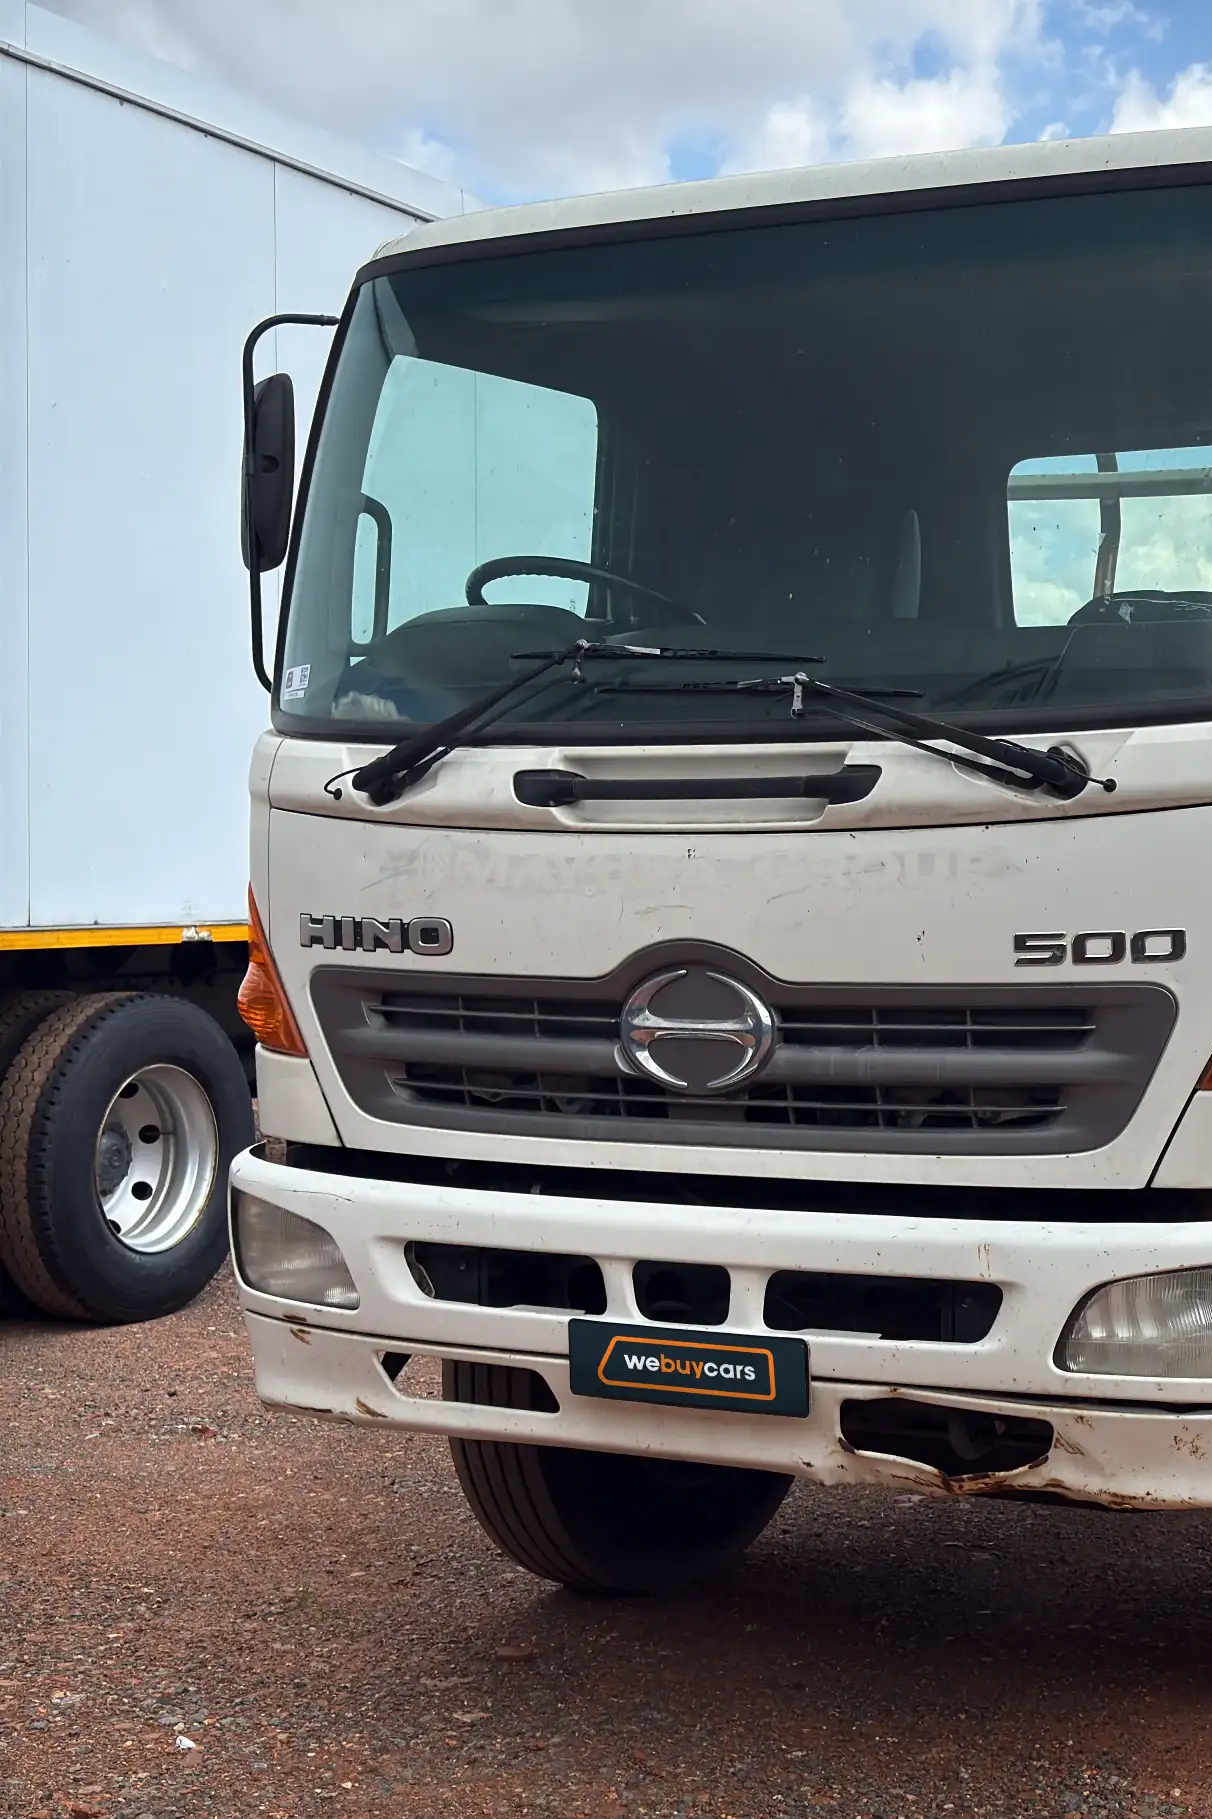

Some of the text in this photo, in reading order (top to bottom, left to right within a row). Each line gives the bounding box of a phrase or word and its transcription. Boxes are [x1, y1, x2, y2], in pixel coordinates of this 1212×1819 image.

[300, 913, 454, 956] HINO
[1013, 928, 1187, 967] 500
[623, 1353, 757, 1381] webuycars
